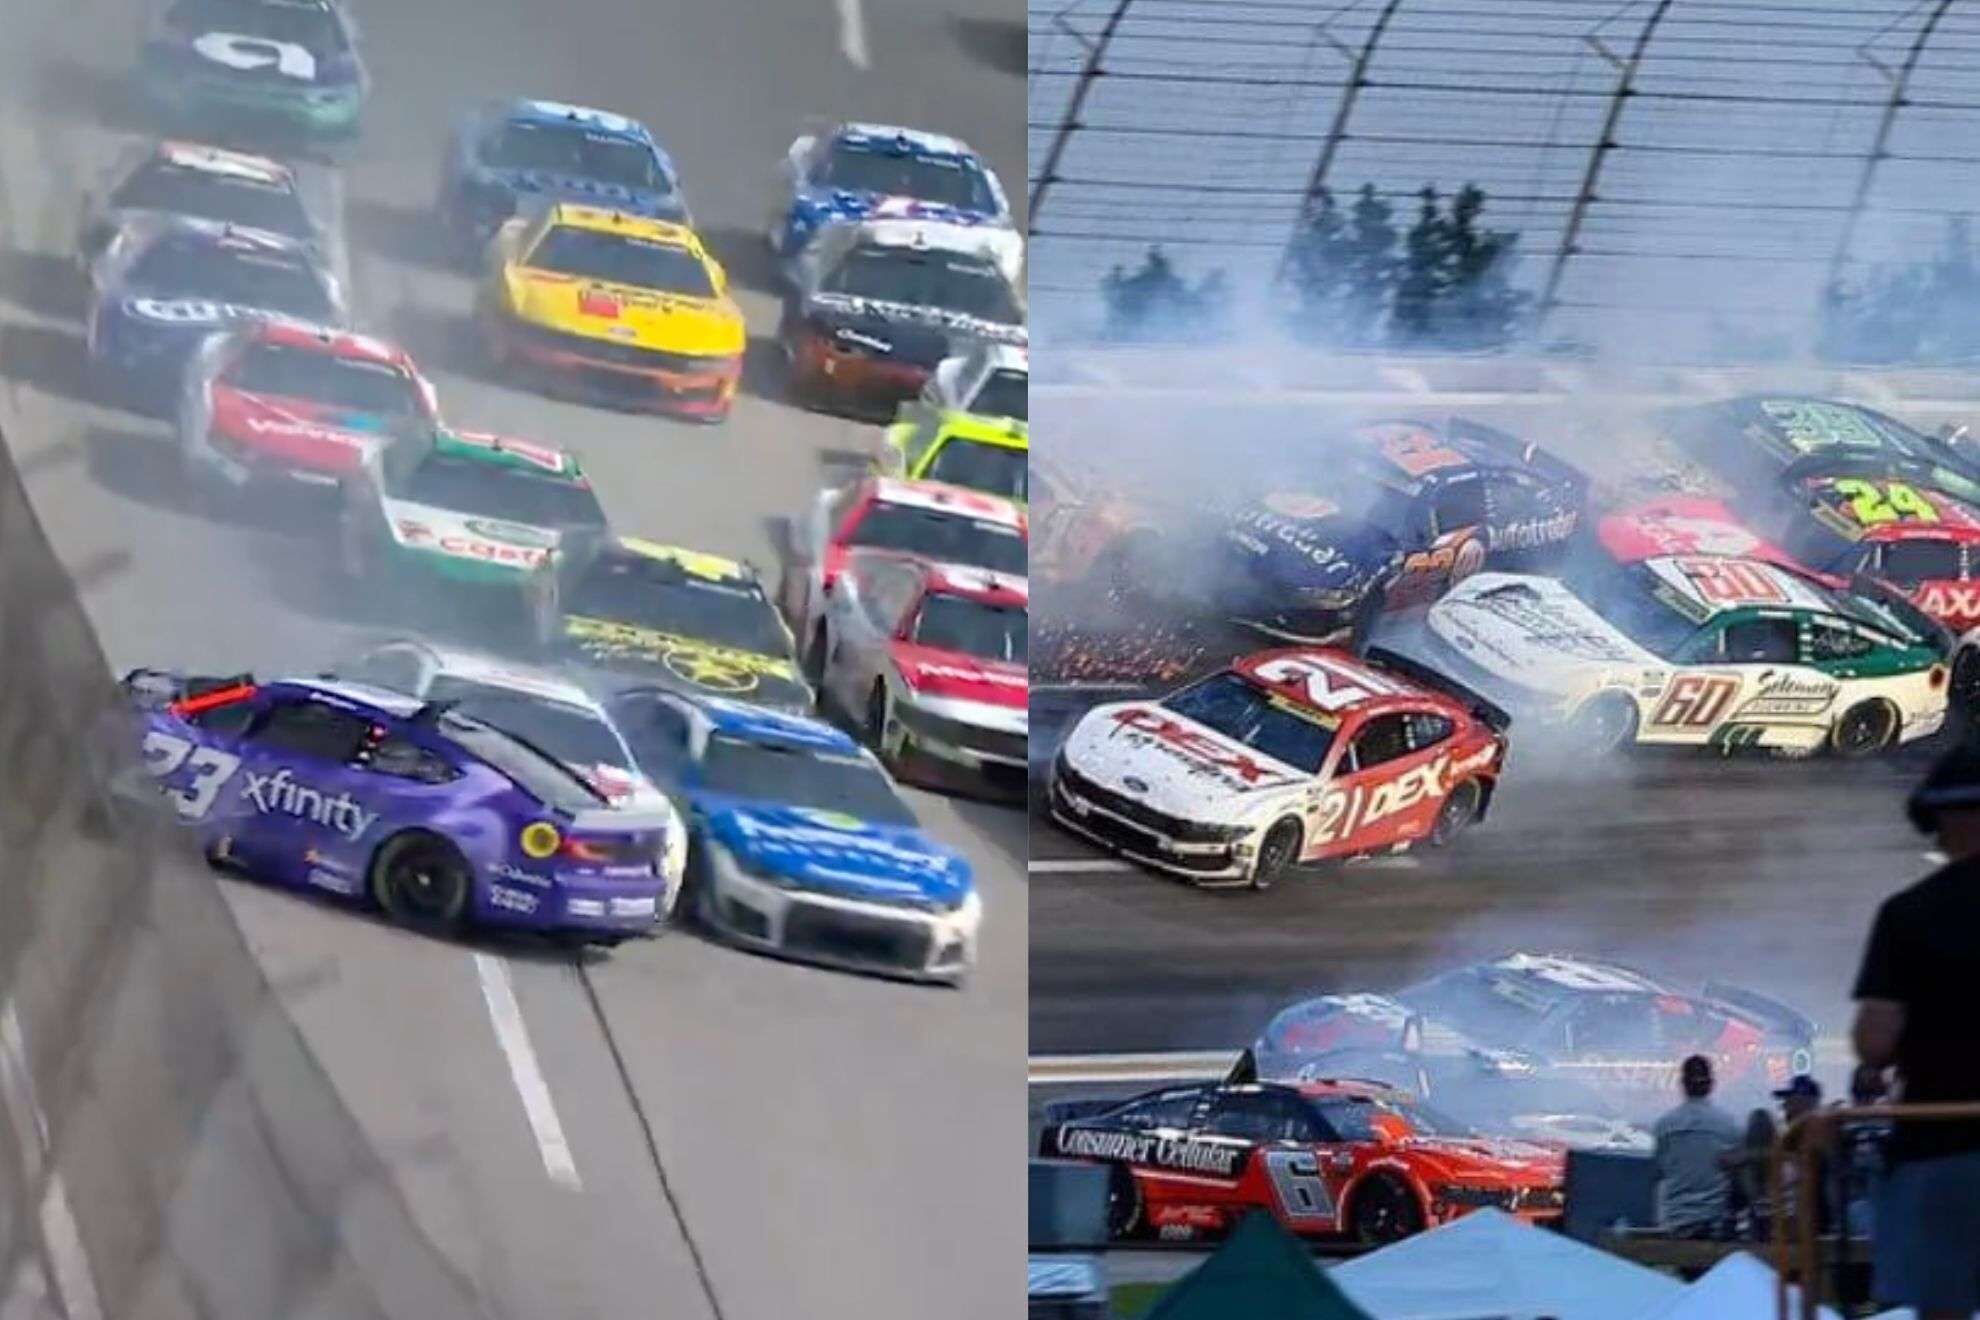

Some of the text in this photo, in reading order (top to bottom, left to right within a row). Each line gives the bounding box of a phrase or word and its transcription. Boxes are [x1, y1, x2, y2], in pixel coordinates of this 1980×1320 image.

[1834, 479, 1940, 525] 24
[1653, 676, 1738, 725] 60
[240, 769, 379, 842] xfinity
[1311, 785, 1364, 846] 21
[1361, 755, 1451, 826] DEX
[1057, 1122, 1236, 1175] Consumer Cellular
[1264, 1151, 1334, 1216] 6
